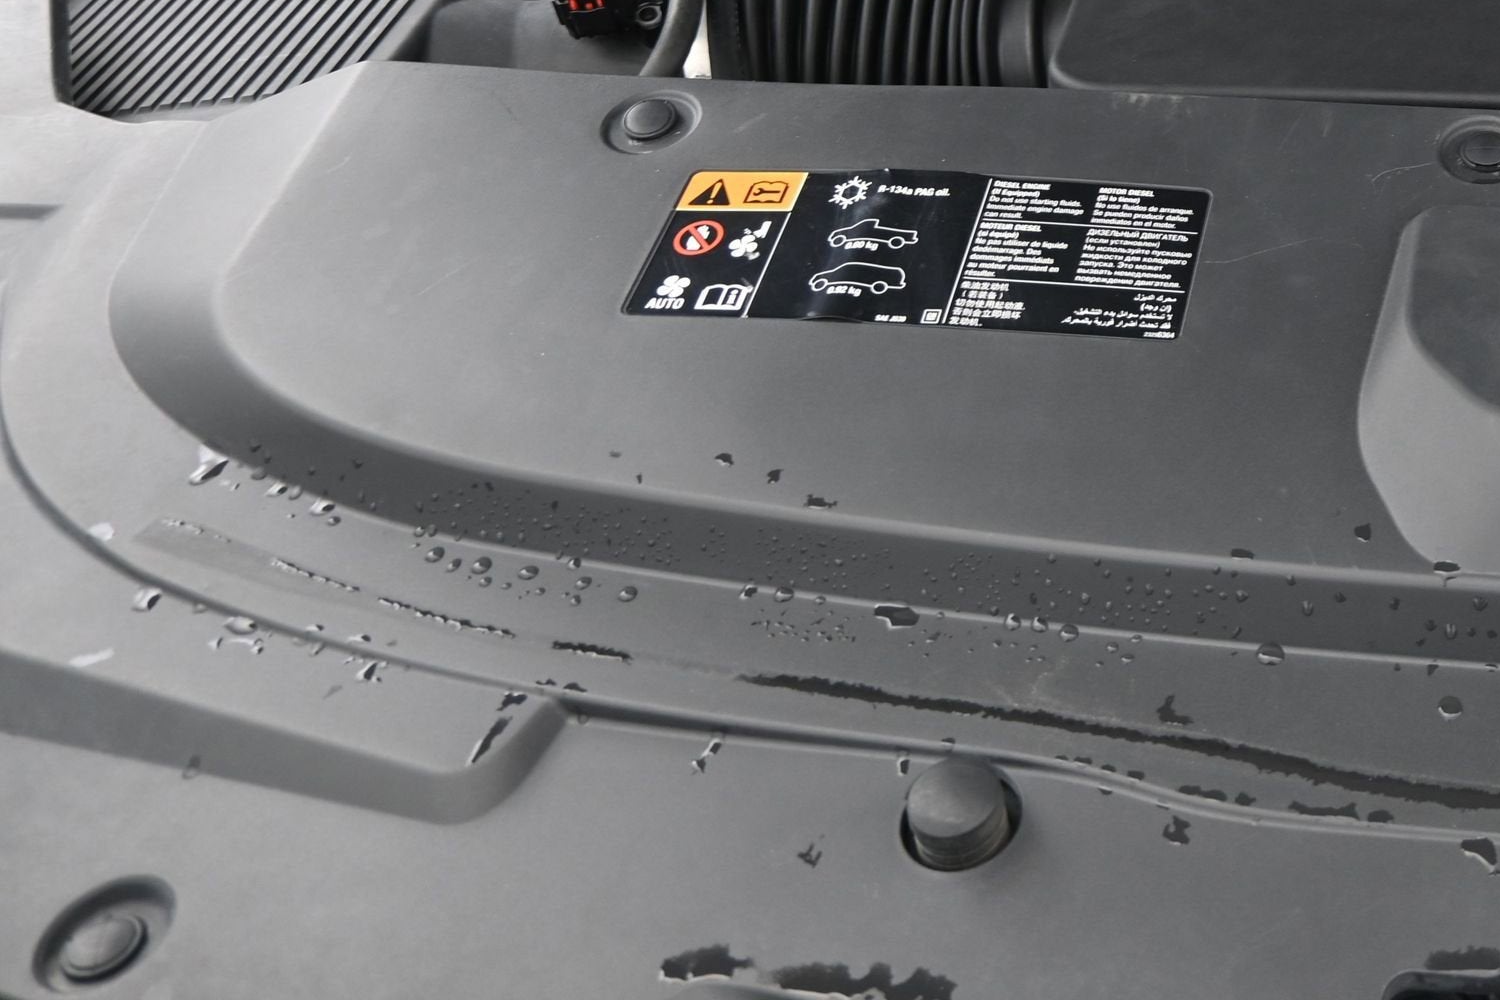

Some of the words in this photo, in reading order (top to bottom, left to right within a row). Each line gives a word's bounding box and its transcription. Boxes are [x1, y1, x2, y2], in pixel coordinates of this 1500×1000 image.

[877, 185, 914, 195] R-134a
[913, 187, 935, 196] PAG
[935, 188, 950, 196] oil.
[993, 180, 1021, 189] DIESEL
[1022, 182, 1051, 190] ENGINE
[1001, 189, 1040, 198] Equipped)
[1099, 187, 1127, 195] MOTOR
[1127, 189, 1155, 197] DIESEL
[1029, 198, 1059, 207] starting
[1059, 199, 1082, 207] fluids.
[986, 203, 1026, 211] Immediate
[1053, 207, 1084, 216] damage
[1159, 207, 1194, 216] arranque.
[1132, 212, 1165, 220] producir
[1165, 214, 1189, 223] daños
[980, 222, 1014, 230] MOTEUR
[1014, 224, 1042, 232] DIESEL
[1086, 228, 1140, 238] ДИЗЕЛЬНЫЙ
[1140, 232, 1189, 242] ДВИГАТЕЛЬ
[865, 241, 879, 251] kg
[986, 238, 1002, 246] pas
[1041, 241, 1069, 249] liquide
[1085, 236, 1109, 244] (если
[1110, 239, 1161, 249] установлен)
[1026, 248, 1042, 256] Des
[1096, 247, 1151, 255] используйте
[1151, 250, 1192, 258] пусковые
[970, 253, 1012, 262] dommages
[1013, 255, 1054, 264] immédiats
[1081, 253, 1124, 261] жидкости
[1142, 257, 1188, 266] холодного
[1007, 264, 1049, 272] pourraient
[1078, 260, 1115, 268] запуска.
[1116, 261, 1134, 269] Это
[1134, 263, 1164, 271] может
[1076, 268, 1113, 276] вызвать
[1113, 270, 1172, 280] немедленное
[1074, 275, 1134, 285] повреждение
[847, 286, 862, 297] kg
[644, 297, 685, 309] AUTO
